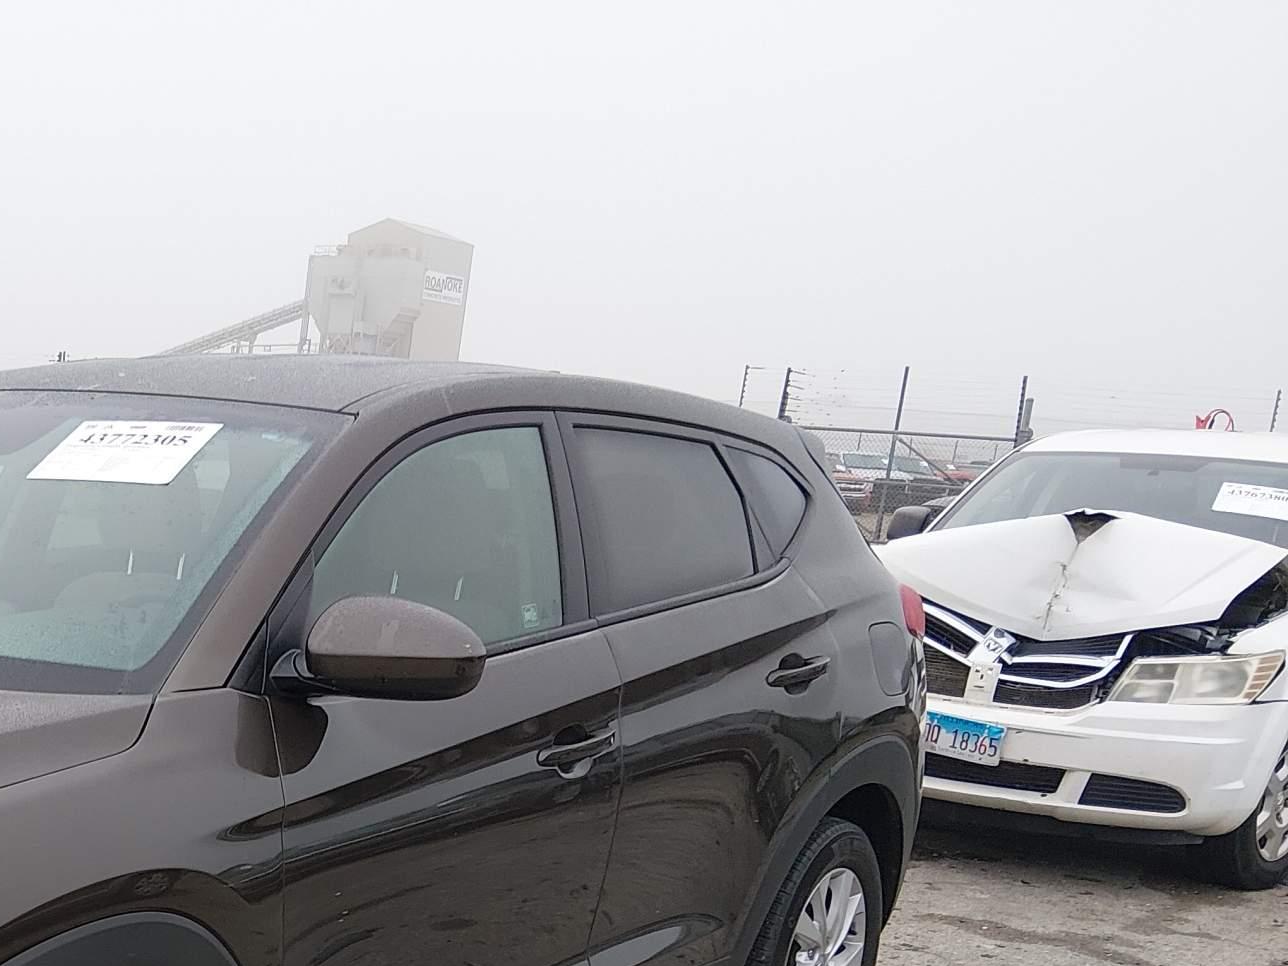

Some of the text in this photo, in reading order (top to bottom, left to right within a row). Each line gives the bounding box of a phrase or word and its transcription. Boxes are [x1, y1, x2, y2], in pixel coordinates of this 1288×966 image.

[424, 275, 463, 294] ROANOKE
[79, 432, 192, 447] 43772305
[949, 729, 1000, 758] 18365
